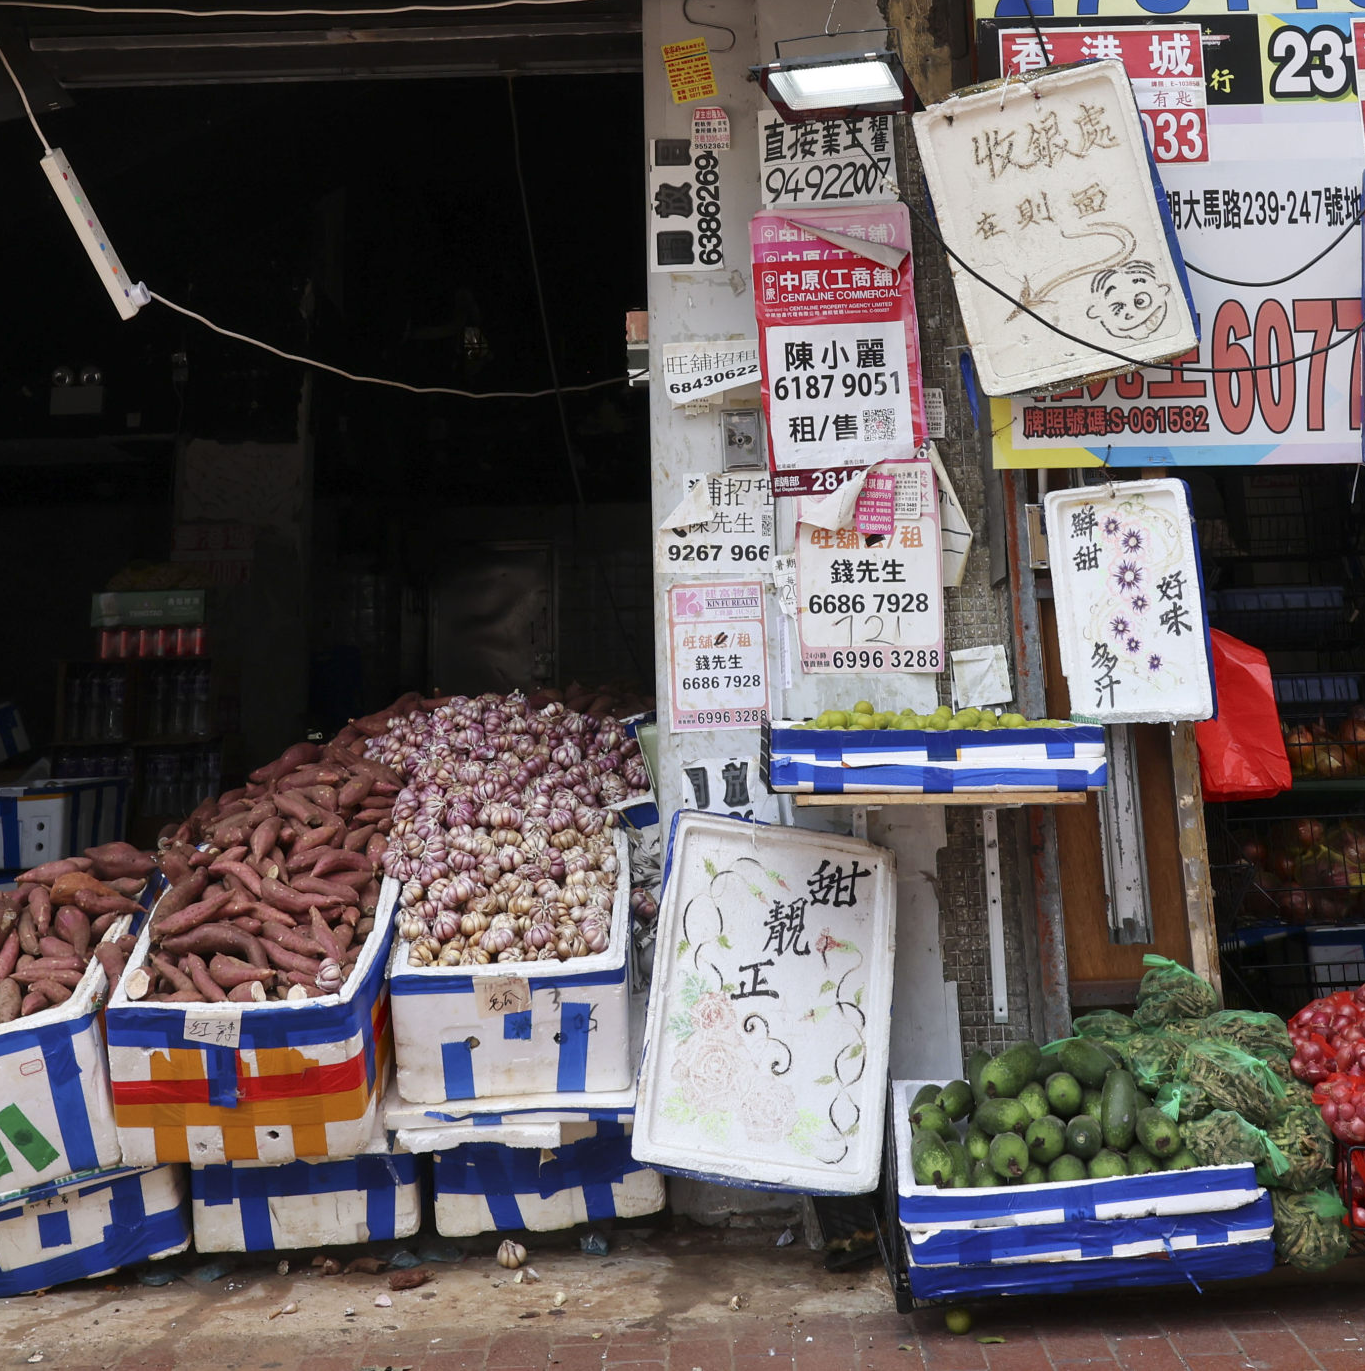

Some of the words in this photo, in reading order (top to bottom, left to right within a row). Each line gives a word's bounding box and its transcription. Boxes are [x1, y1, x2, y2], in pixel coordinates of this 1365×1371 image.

[781, 292, 834, 303] CENTALINE
[836, 287, 902, 301] COMMERCIAL
[785, 339, 885, 371] 陳小麗
[669, 364, 758, 394] 68430622
[774, 375, 834, 400] 6187
[842, 371, 899, 397] 9051
[668, 545, 722, 562] 9267
[831, 559, 906, 584] 錢先生
[732, 598, 758, 606] REALTY
[809, 594, 865, 614] 6686
[873, 593, 929, 613] 7928
[695, 654, 743, 670] 錢先生
[833, 650, 884, 669] 6996
[891, 650, 939, 668] 3288
[683, 677, 720, 690] 6686
[725, 675, 761, 688] 7928
[697, 711, 731, 724] 6996
[735, 710, 767, 722] 3288
